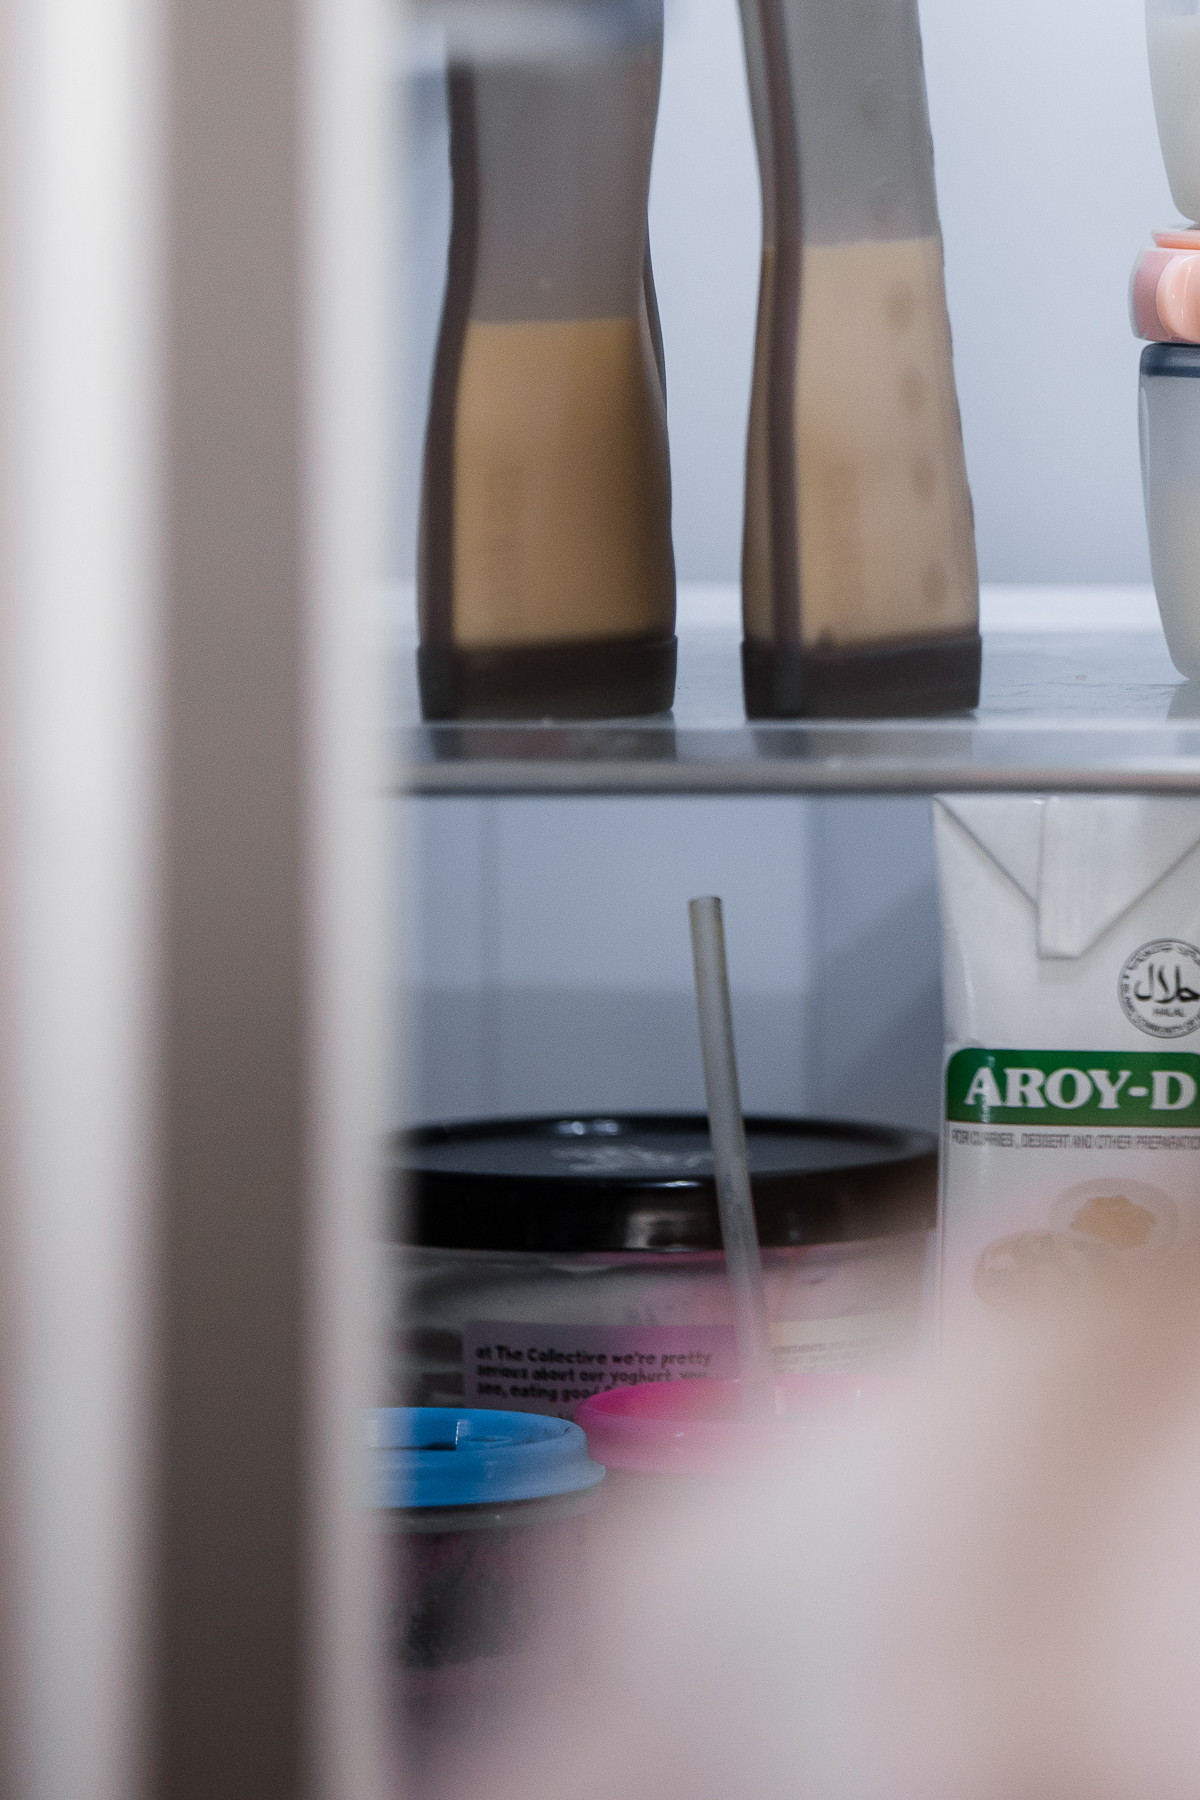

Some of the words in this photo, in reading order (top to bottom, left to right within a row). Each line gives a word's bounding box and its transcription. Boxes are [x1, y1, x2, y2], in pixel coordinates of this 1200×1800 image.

[964, 1066, 1198, 1111] AROY-D
[476, 1345, 492, 1360] at
[495, 1344, 523, 1361] The
[527, 1347, 607, 1365] Collective
[611, 1350, 657, 1366] we're
[661, 1350, 711, 1369] pretty
[477, 1365, 528, 1380] serious
[532, 1366, 575, 1382] about
[579, 1370, 604, 1382] our
[510, 1383, 558, 1402] eating
